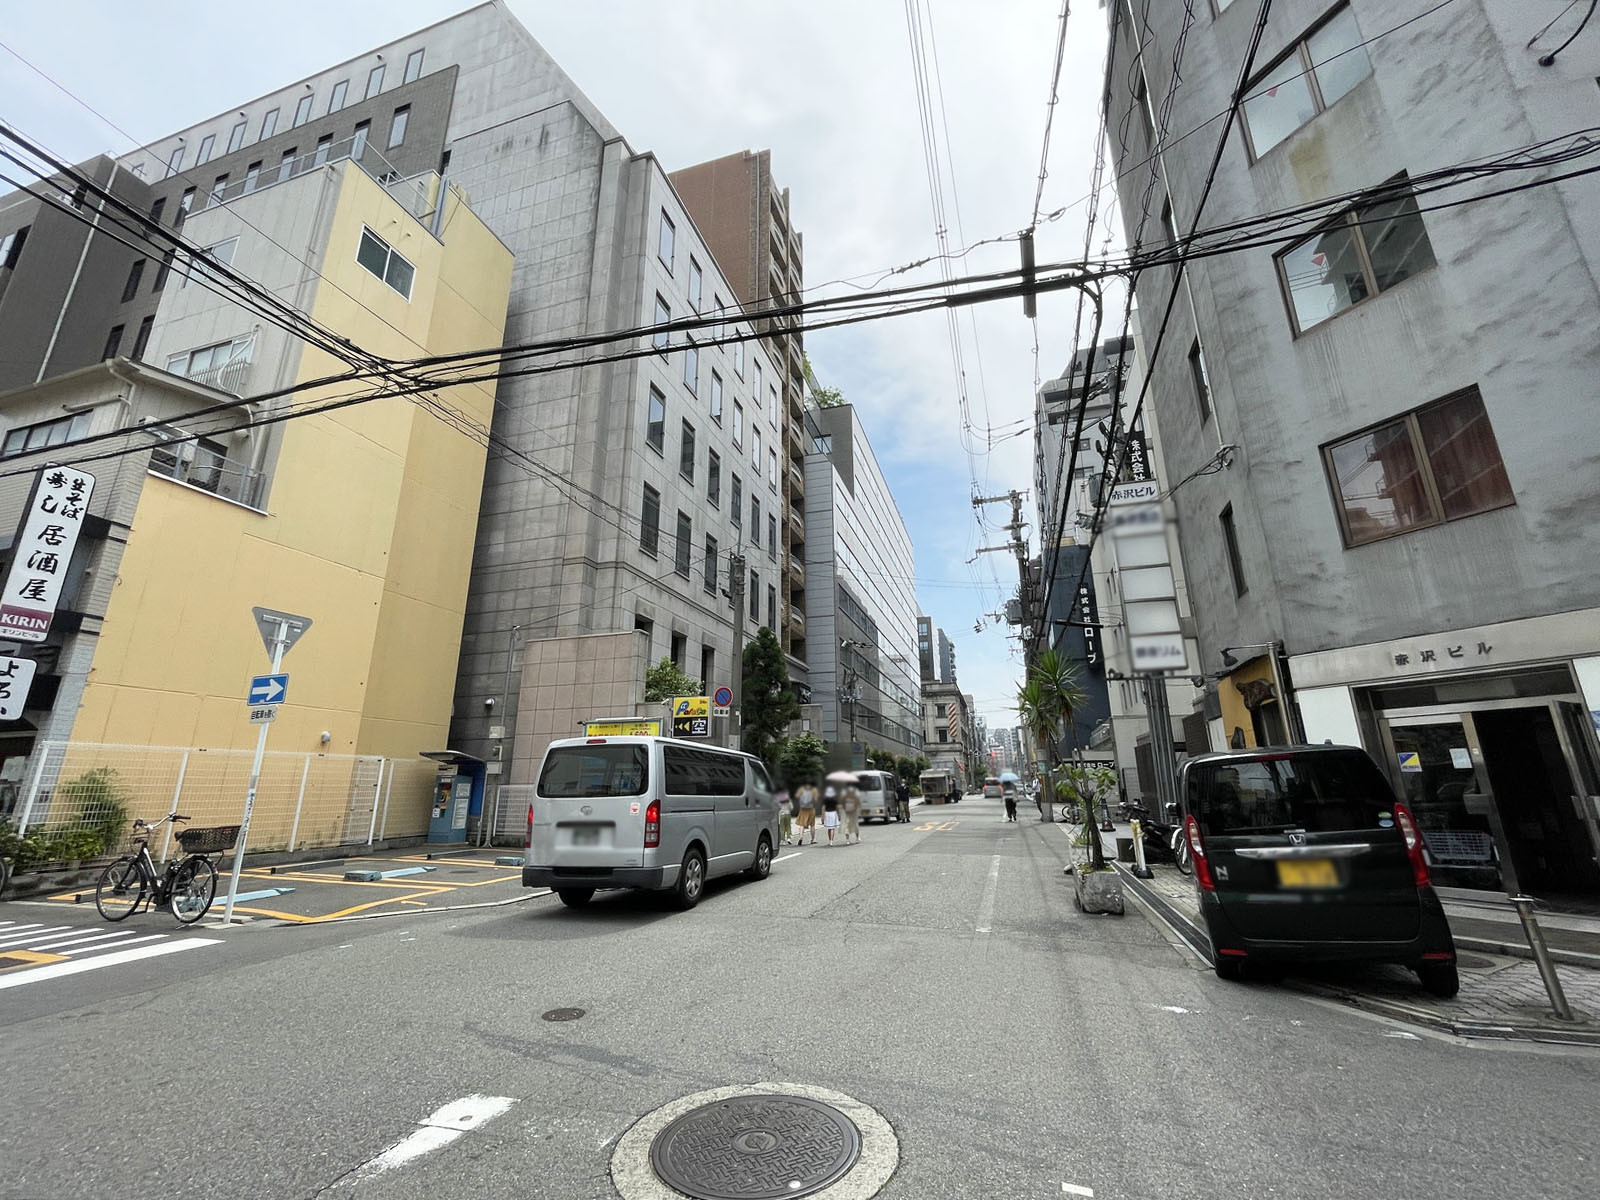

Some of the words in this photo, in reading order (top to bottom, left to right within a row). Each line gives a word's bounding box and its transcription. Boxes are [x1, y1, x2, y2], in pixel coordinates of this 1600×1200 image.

[61, 478, 86, 520] 生そば
[1111, 486, 1156, 500] 赤沢ビル
[19, 524, 67, 602] 居酒屋
[1, 613, 48, 629] KIRIN
[2, 628, 39, 639] キリンビール
[1394, 642, 1493, 666] 赤沢ビル
[691, 718, 706, 734] 空
